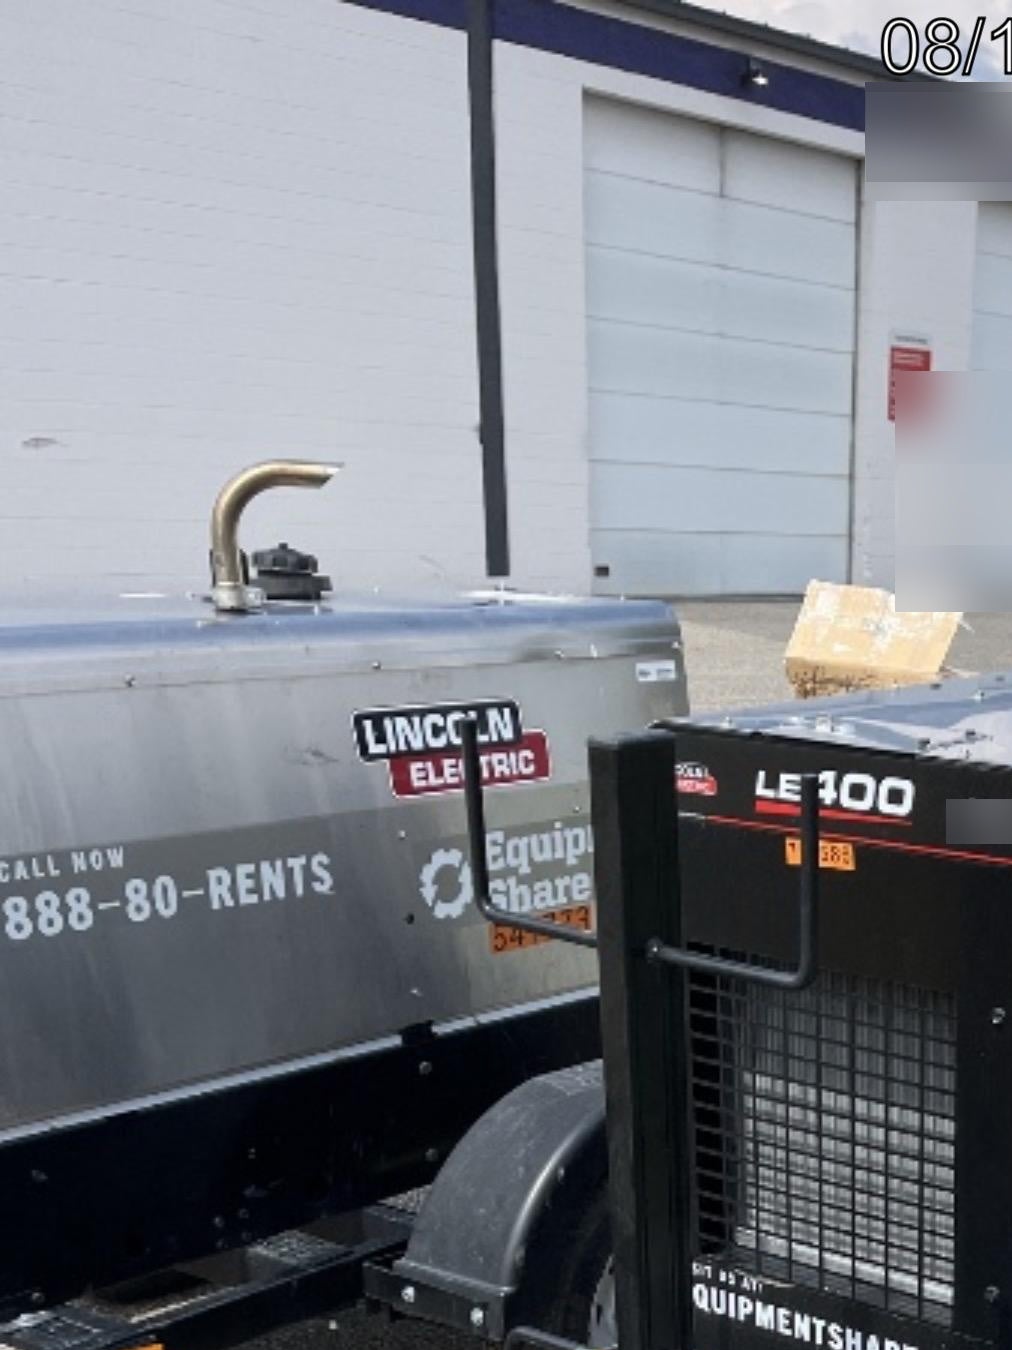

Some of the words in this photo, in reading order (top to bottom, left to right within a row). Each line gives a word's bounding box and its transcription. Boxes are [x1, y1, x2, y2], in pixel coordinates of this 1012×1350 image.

[0, 854, 61, 884] CALL
[71, 846, 125, 874] NOW
[486, 821, 594, 874] Equip
[3, 851, 335, 941] 888-80-RENTS
[488, 872, 593, 913] Share
